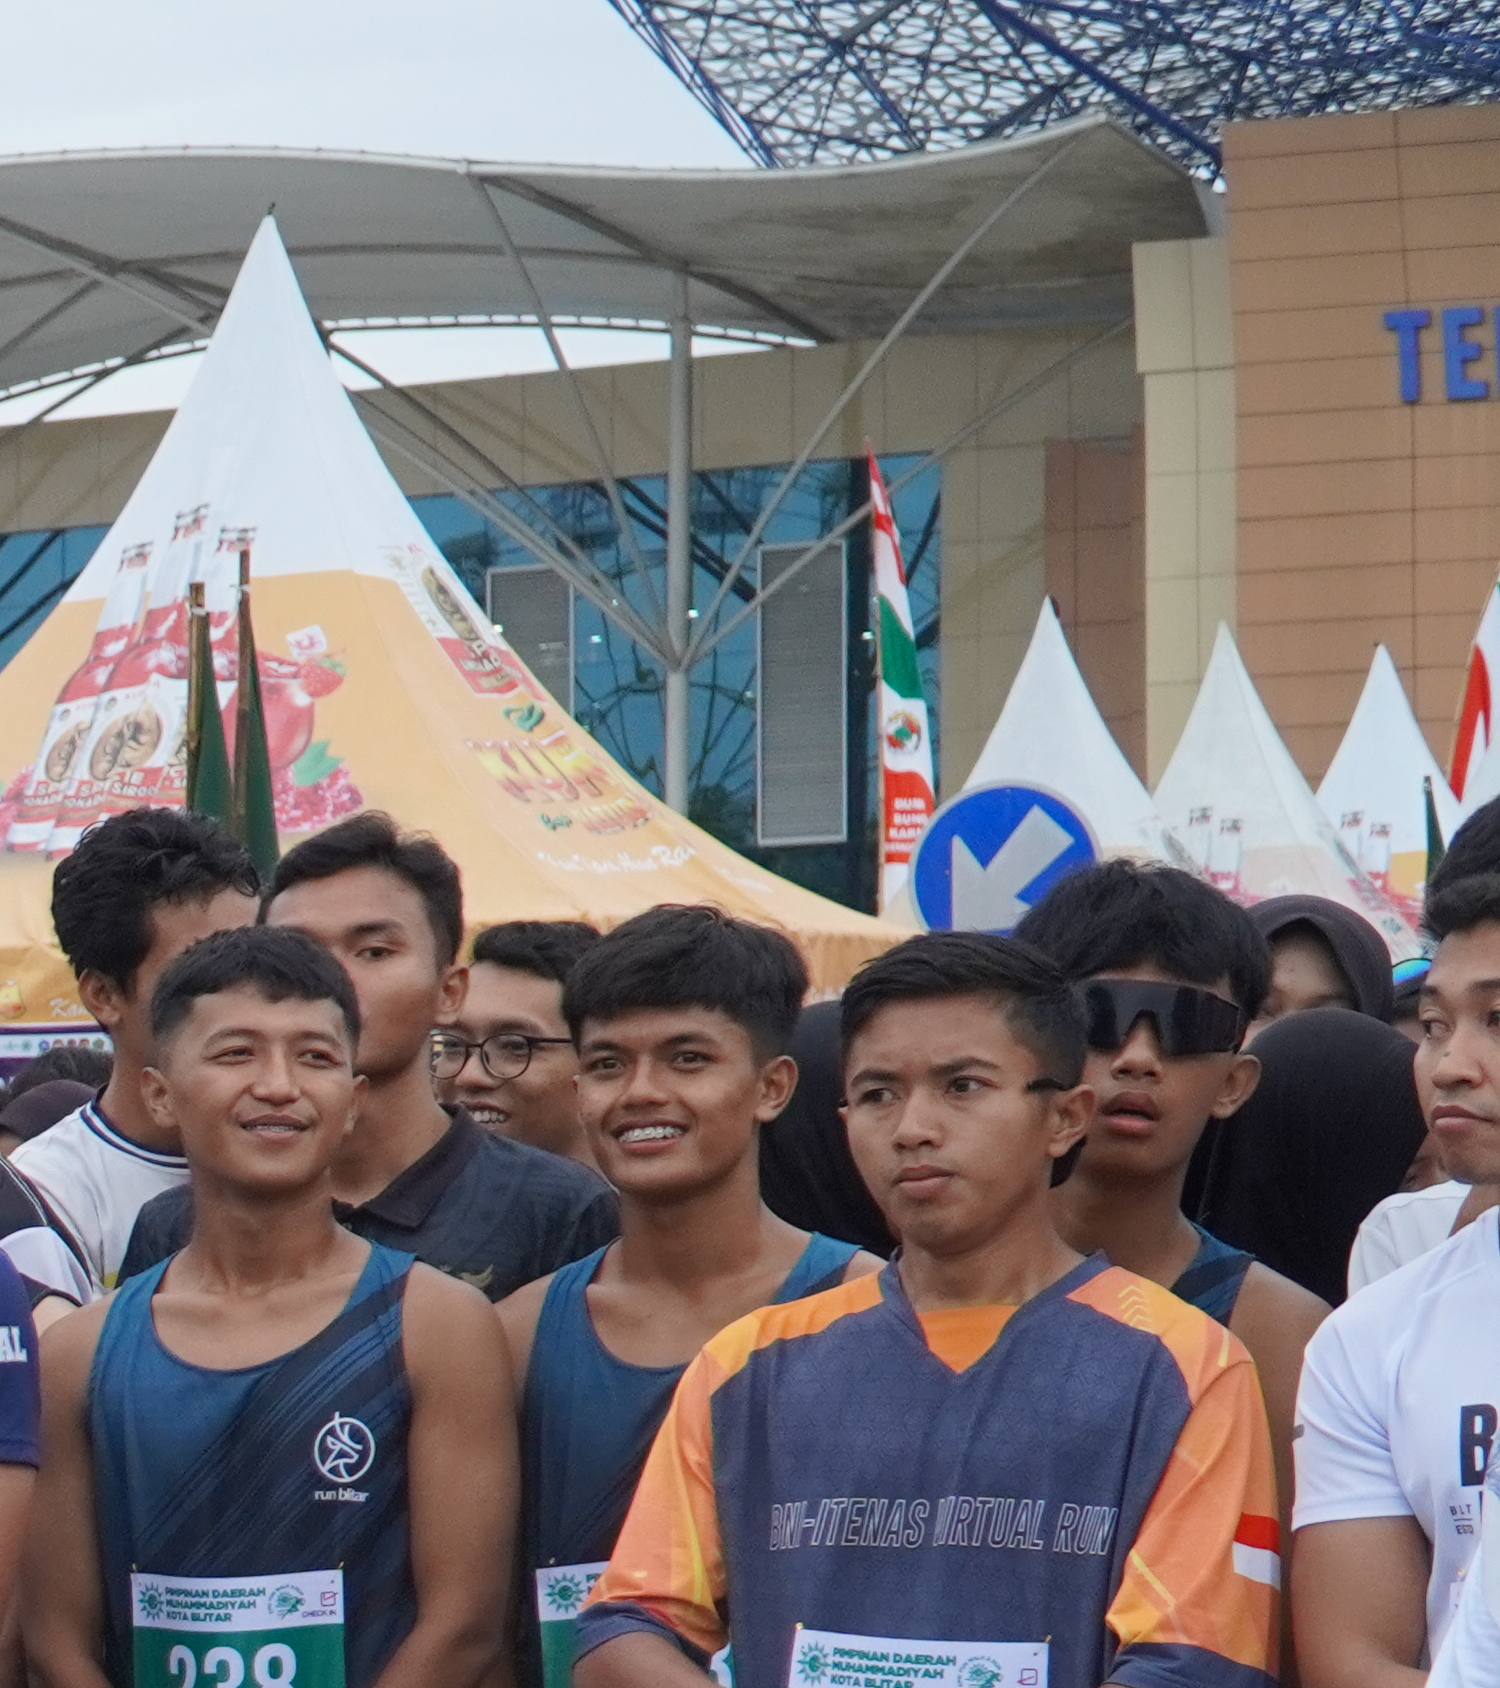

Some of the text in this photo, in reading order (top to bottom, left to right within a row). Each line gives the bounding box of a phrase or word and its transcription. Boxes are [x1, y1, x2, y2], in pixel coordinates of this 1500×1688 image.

[1384, 306, 1500, 402] TE
[1459, 1403, 1499, 1488] B
[315, 1489, 337, 1501] run
[1052, 1502, 1118, 1557] RUN
[164, 1586, 267, 1599] PIMPINAN DAERAH
[164, 1598, 257, 1611] MUHAMMADIYAH
[166, 1611, 233, 1623] KOTA BLITAR
[832, 1647, 957, 1667] PIMPINAN DAERAH
[831, 1660, 945, 1679] MUHAMMADIYAH
[830, 1674, 862, 1687] KOTA
